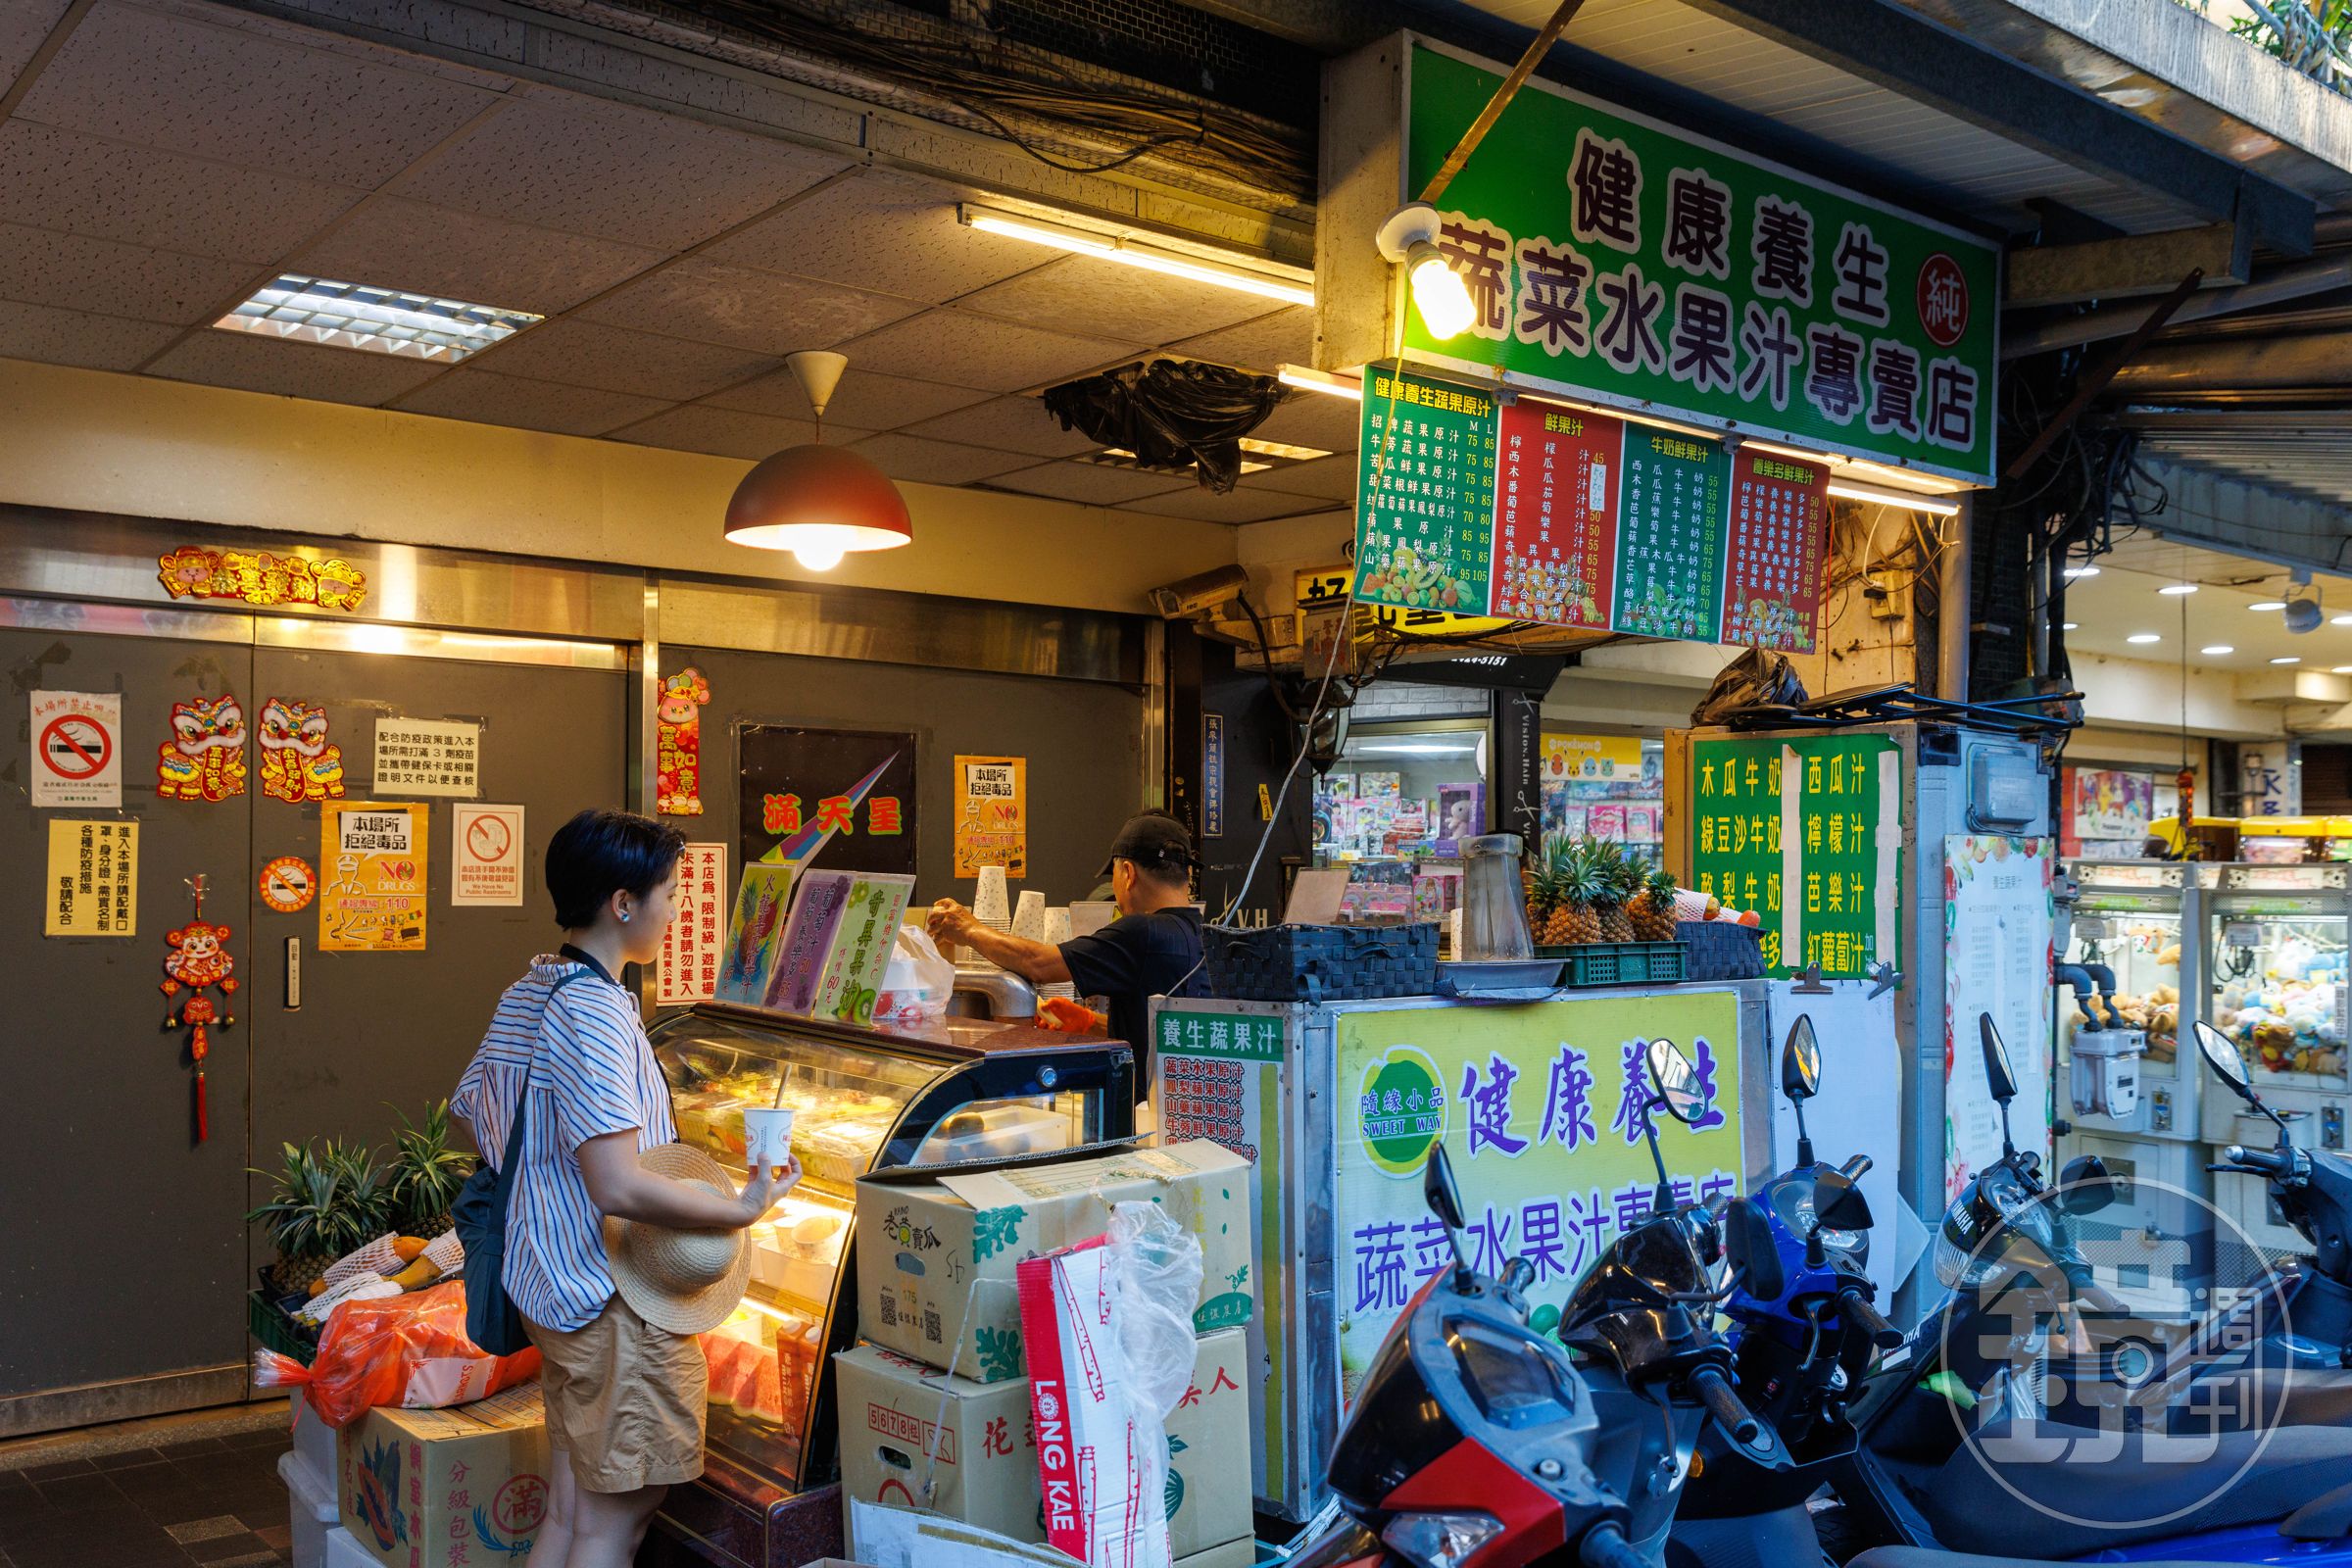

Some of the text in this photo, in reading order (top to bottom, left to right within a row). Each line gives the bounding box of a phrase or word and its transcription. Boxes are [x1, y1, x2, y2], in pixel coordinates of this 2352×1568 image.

[1571, 130, 1888, 325] 健康養生
[1925, 272, 1961, 334] 純
[1436, 215, 1975, 449] 蔬菜水果汁專賣店
[1375, 376, 1491, 418] 健康養生蔬果原汁
[1372, 414, 1494, 450] 招牌蔬果原汁 75 85
[1470, 420, 1493, 434] M L
[1544, 413, 1584, 437] 鮮果汁
[1371, 434, 1494, 468] 牛蒡蔬果原汁 75 85
[1510, 435, 1604, 464] 檸檬汁 45
[1651, 436, 1708, 463] 牛奶鮮果汁
[1370, 454, 1493, 487] 苦瓜鮮果原汁 75 85
[1509, 451, 1588, 475] 西瓜汁
[1632, 460, 1718, 487] 西瓜牛奶 55
[1753, 458, 1814, 485] 養樂多鮮果汁
[1368, 473, 1492, 507] 甜菜根鮮果原汁 75 85
[1508, 466, 1588, 490] 木瓜汁
[1632, 474, 1717, 501] 木瓜牛奶 55
[1508, 480, 1587, 505] 番茄汁
[1632, 488, 1716, 514] 香蕉牛奶 55
[1463, 511, 1474, 522] 70
[1480, 514, 1490, 525] 80
[1507, 495, 1600, 521] 葡萄汁 50
[1631, 502, 1715, 528] 芭樂牛奶 55
[1367, 512, 1489, 544] 蘋果原汁 85 95
[1506, 510, 1600, 536] 芭樂汁 50
[1630, 516, 1714, 541] 葡萄牛奶 55
[1366, 532, 1488, 564] 蘋果鳳梨原汁 75 85
[1505, 525, 1599, 551] 蘋果汁 55
[1628, 530, 1698, 552] 蘋果牛奶
[1505, 540, 1598, 565] 奇異果汁 65
[1627, 545, 1698, 566] 香蕉木瓜牛奶
[1460, 568, 1470, 580] 95
[1473, 569, 1488, 581] 105
[1504, 555, 1596, 579] 奇異果鳳梨汁 75
[1627, 560, 1697, 580] 芒果牛奶
[1586, 583, 1596, 594] 75
[1626, 573, 1696, 594] 草莓牛奶
[1500, 599, 1579, 620] 蘋果鳳梨汁
[1624, 588, 1695, 608] 酪梨牛奶
[378, 731, 475, 746] 配合防疫政策進入本
[378, 746, 428, 758] 場所需打滿
[432, 748, 441, 757] 3
[378, 772, 474, 786] 證明文件以便查核
[976, 768, 1006, 782] 本場所
[1701, 759, 1782, 797] 木瓜牛奶
[1807, 754, 1866, 796] 西瓜汁
[970, 783, 1011, 796] 拒絕毒品
[352, 816, 400, 833] 本場所
[763, 793, 903, 836] 滿天星
[345, 833, 407, 851] 拒絕毒品
[1700, 813, 1781, 855] 綠豆沙牛奶
[1807, 812, 1865, 855] 檸檬汁
[79, 825, 93, 894] 各種防疫措施
[379, 860, 416, 881] NO
[116, 826, 130, 931] 進入本場所請配戴口
[377, 881, 416, 892] DRUGS
[59, 876, 74, 925] 敬請配合
[1807, 872, 1865, 913] 芭樂汁
[680, 852, 694, 996] 未滿十八歲者請勿進入
[840, 889, 885, 1008] 奇異果汁
[1807, 931, 1864, 973] 紅蘿蔔汁
[1163, 1018, 1276, 1054] 養生蔬果汁
[1164, 1056, 1245, 1081] 蔬菜水果原汁
[1164, 1077, 1244, 1102] 鳳梨蘋果原汁
[1361, 1088, 1444, 1115] 隨緣小品
[1164, 1097, 1244, 1121] 山藥蘋果原汁
[1165, 1115, 1245, 1142] 牛蒡鮮果原汁
[1362, 1115, 1442, 1136] SWEET WAY
[447, 1459, 472, 1568] 分級包裝
[503, 1481, 543, 1522] 滿
[1048, 1481, 1075, 1531] KAE
